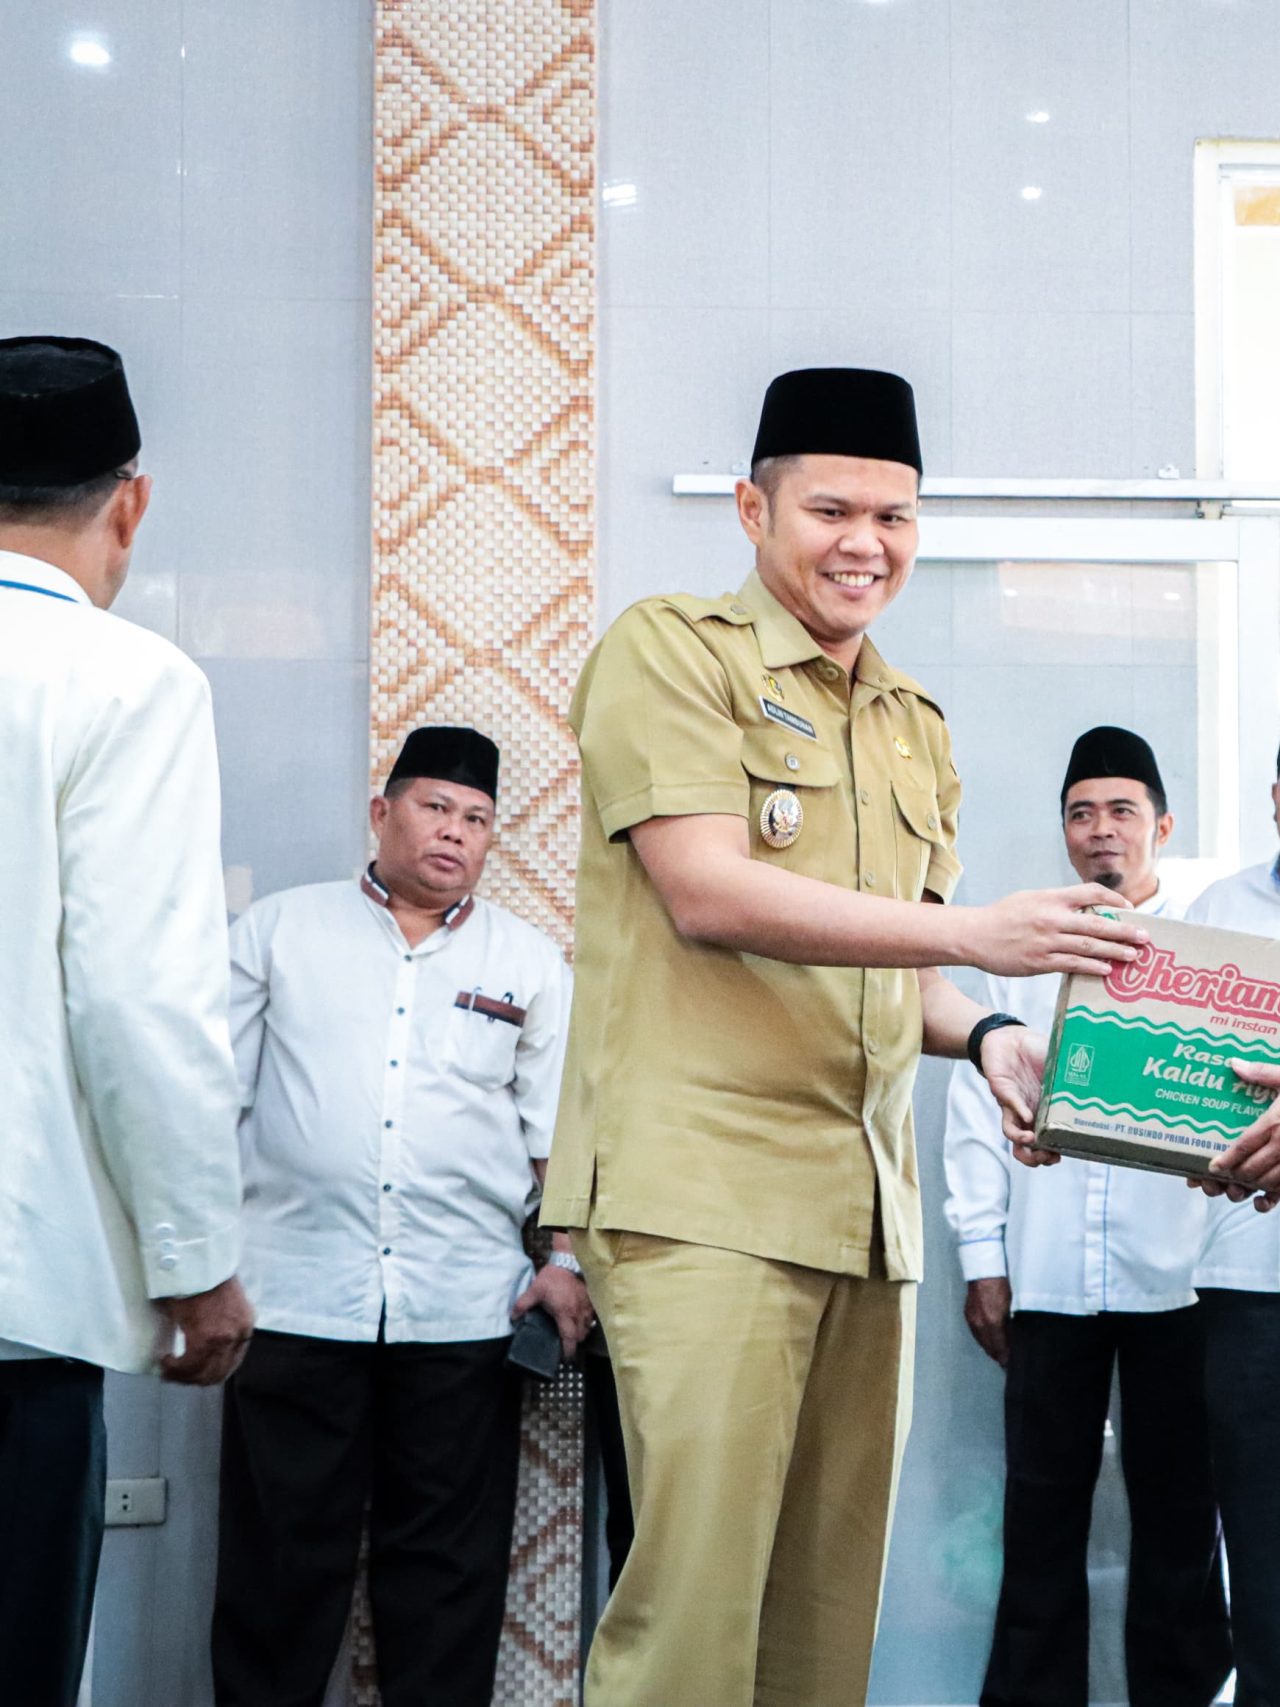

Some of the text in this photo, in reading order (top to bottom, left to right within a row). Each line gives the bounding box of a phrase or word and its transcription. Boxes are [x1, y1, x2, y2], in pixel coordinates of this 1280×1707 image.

[1210, 1016, 1278, 1035] mi instan
[1143, 1056, 1225, 1091] Kaldu
[1155, 1088, 1200, 1105] CHICKEN
[1201, 1097, 1230, 1110] SOUP
[1164, 1133, 1189, 1146] PRIMA
[1191, 1138, 1212, 1149] FOOD
